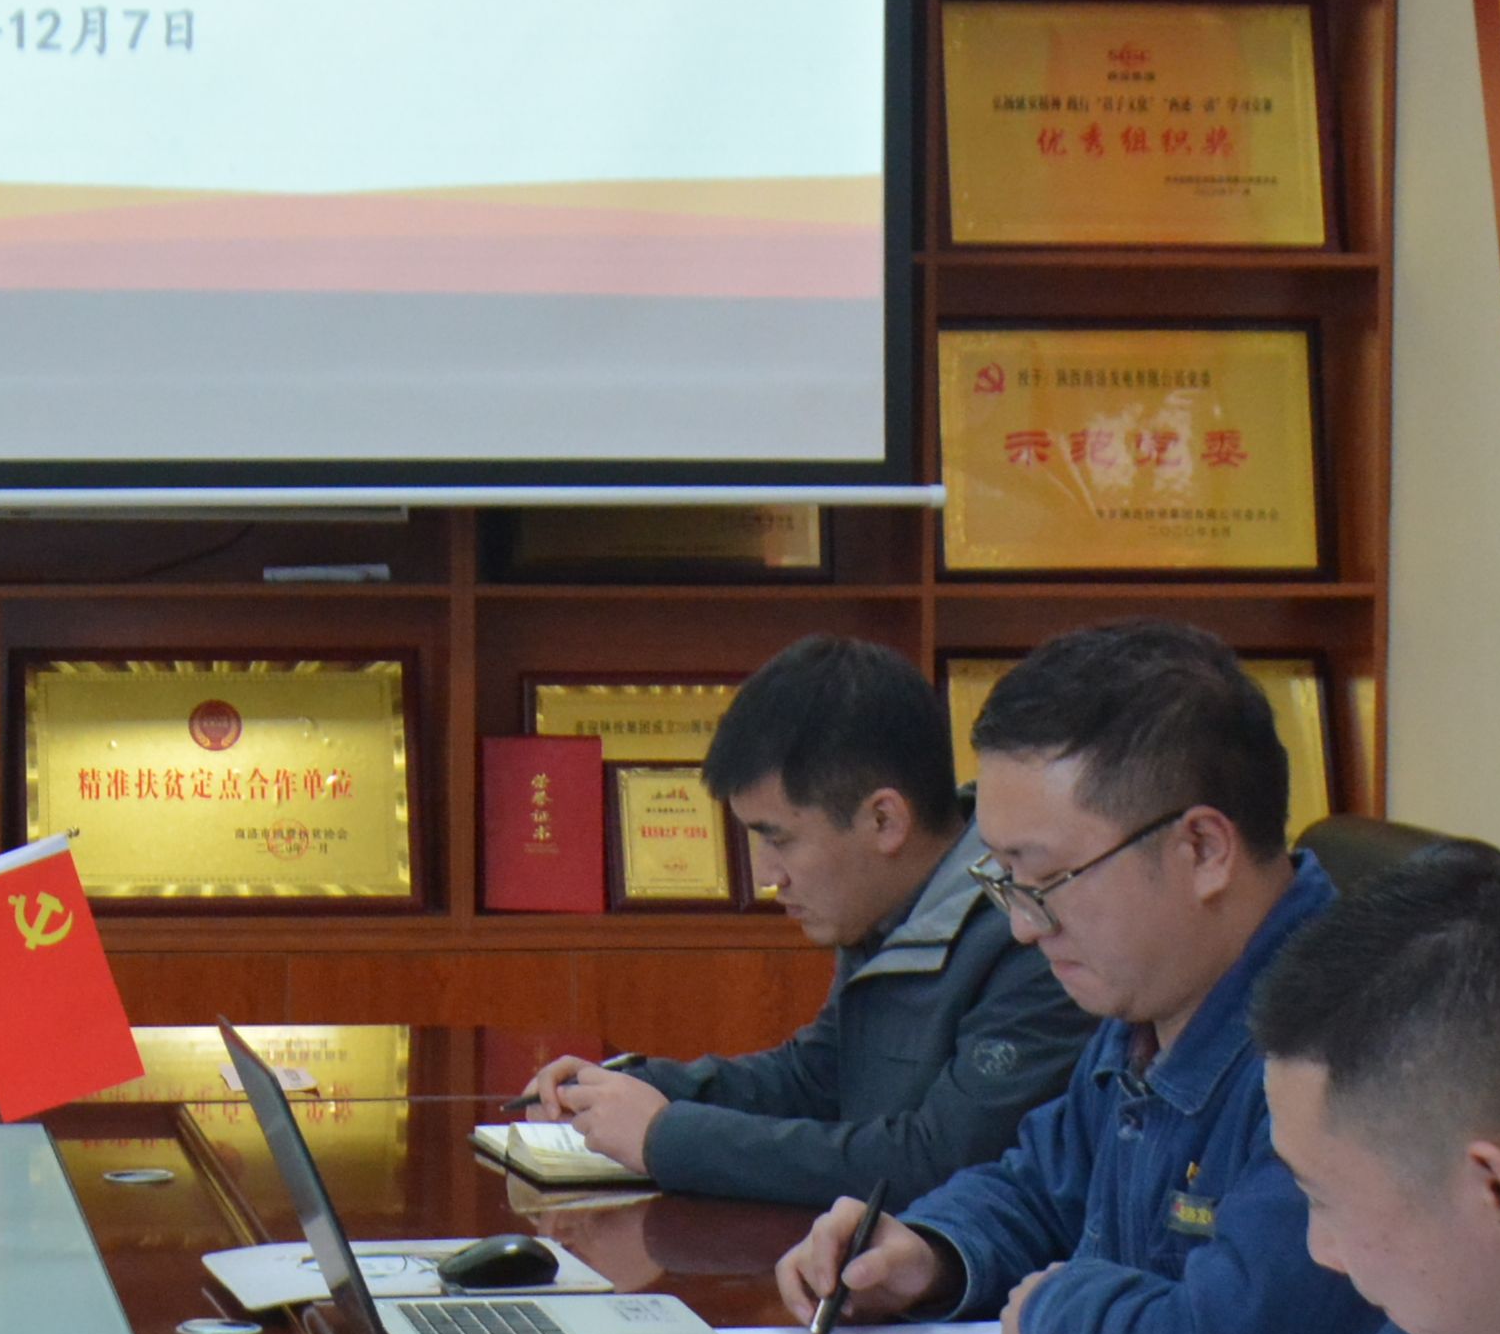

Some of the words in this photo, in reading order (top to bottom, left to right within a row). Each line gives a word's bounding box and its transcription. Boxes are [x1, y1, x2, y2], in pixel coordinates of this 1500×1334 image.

[1036, 122, 1235, 161] 优秀组织奖
[1004, 428, 1249, 468] 示范党委
[77, 766, 355, 802] 精准扶贫定点合作单位
[530, 772, 554, 842] 荣誉证书
